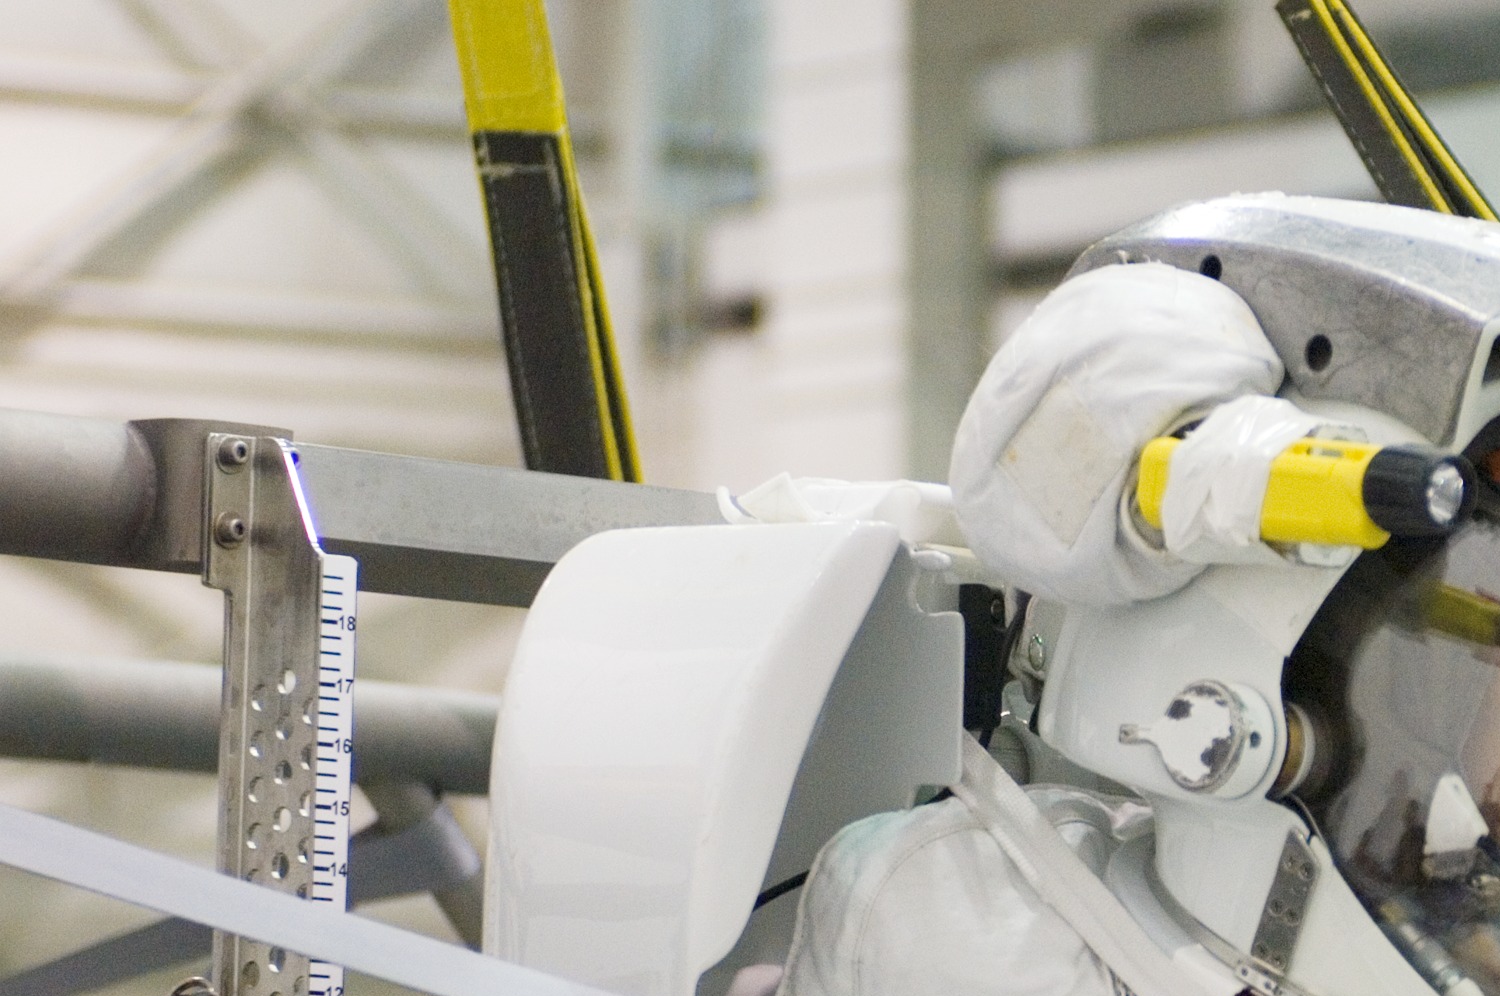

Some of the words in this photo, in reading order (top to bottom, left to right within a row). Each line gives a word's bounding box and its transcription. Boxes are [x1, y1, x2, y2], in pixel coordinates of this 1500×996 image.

[339, 616, 356, 631] 18
[337, 679, 353, 693] 17
[335, 739, 352, 754] 16
[333, 801, 349, 815] 15
[330, 862, 346, 877] 14
